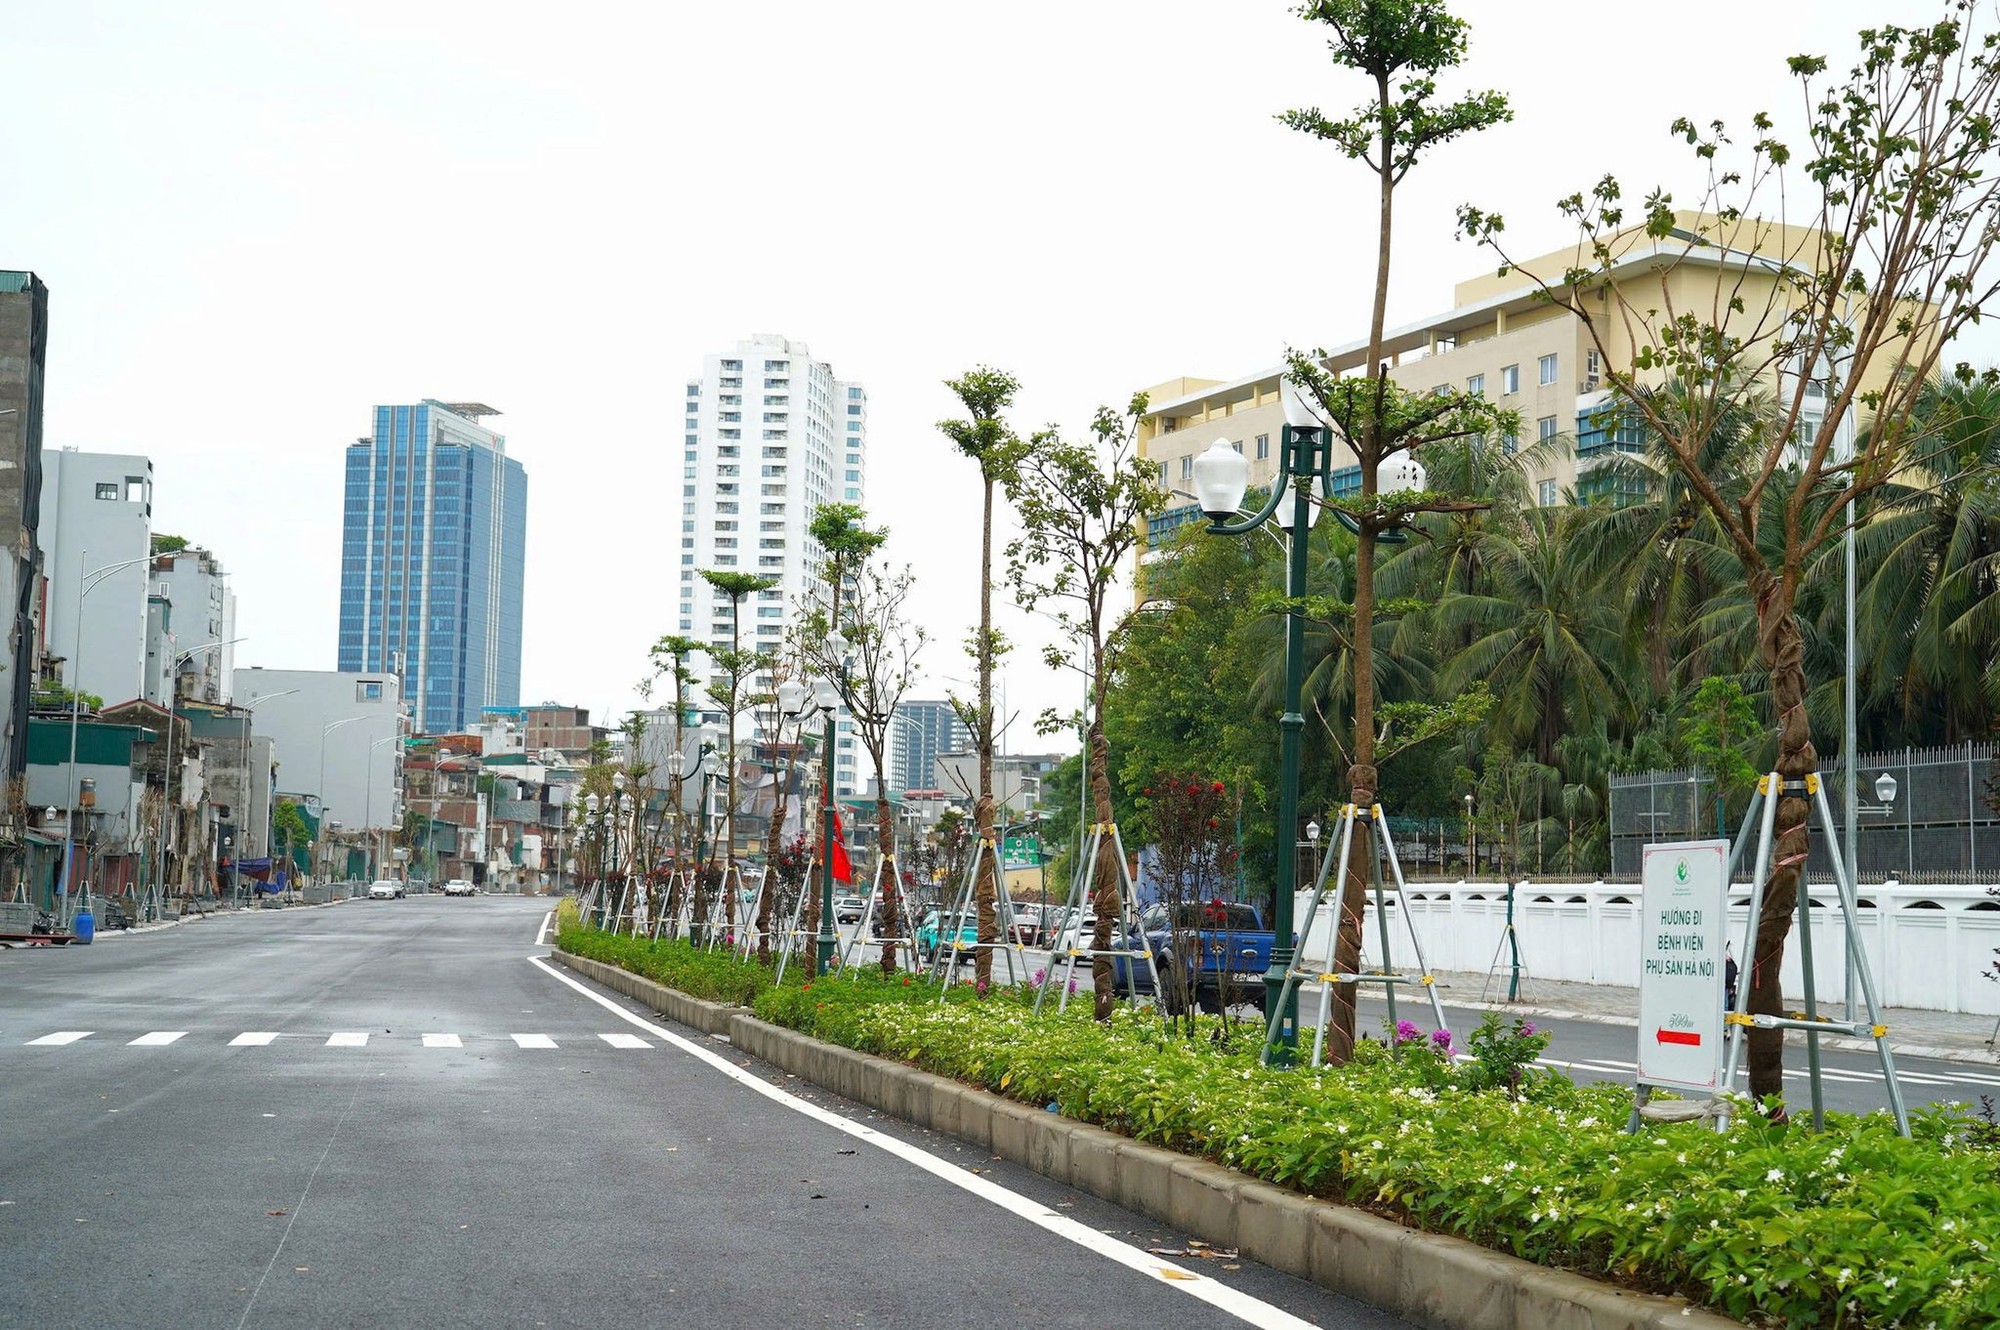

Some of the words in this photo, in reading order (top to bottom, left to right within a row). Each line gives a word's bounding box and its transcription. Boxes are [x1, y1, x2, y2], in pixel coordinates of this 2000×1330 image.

[1661, 907, 1691, 925] HƯỚNG
[1693, 910, 1702, 925] ĐI
[1658, 932, 1681, 954] BỆNH
[1683, 932, 1703, 954] VIỆN
[1646, 959, 1664, 978] PHỤ
[1685, 957, 1697, 976] HÀ
[1699, 958, 1714, 980] NỘI
